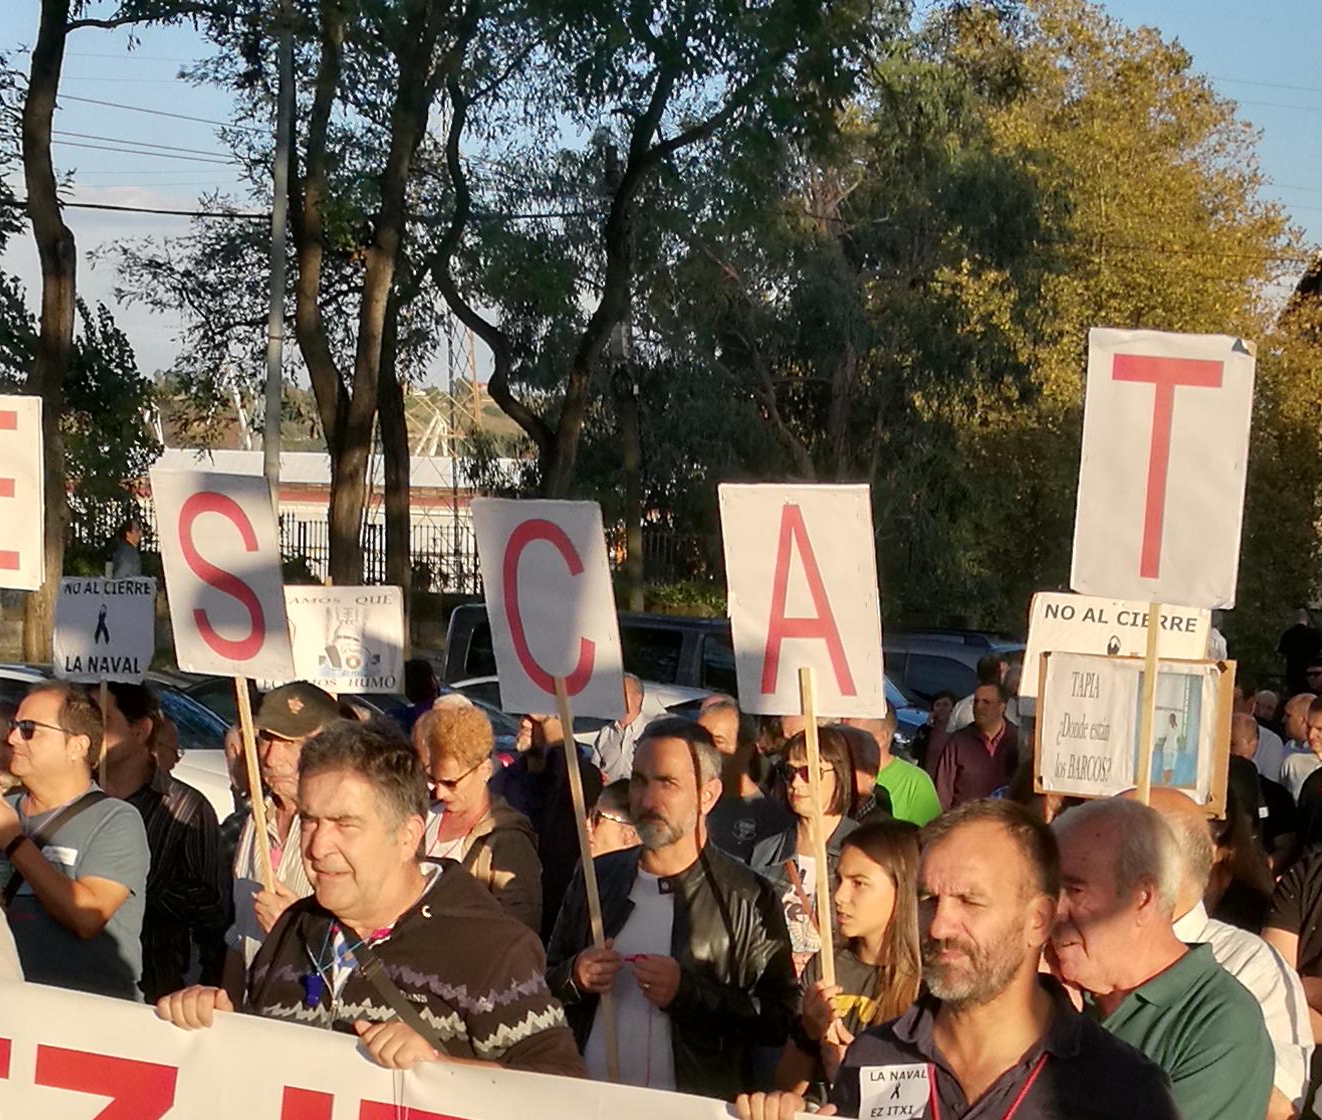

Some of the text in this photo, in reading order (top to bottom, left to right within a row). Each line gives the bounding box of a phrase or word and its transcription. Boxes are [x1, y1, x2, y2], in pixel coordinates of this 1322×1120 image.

[1111, 352, 1224, 580] T
[83, 582, 100, 595] AL
[103, 580, 151, 595] CIERRE
[177, 490, 266, 661] S
[355, 594, 393, 606] QUE
[502, 517, 597, 697] C
[760, 503, 858, 697] A
[1044, 603, 1198, 633] NO AL CIERRE
[65, 655, 141, 674] LA NAVAL
[1071, 671, 1100, 698] TAPIA
[1055, 752, 1112, 782] los BARCOS?
[870, 1069, 927, 1082] LA NAVAL
[870, 1104, 914, 1118] EZ ITXI
